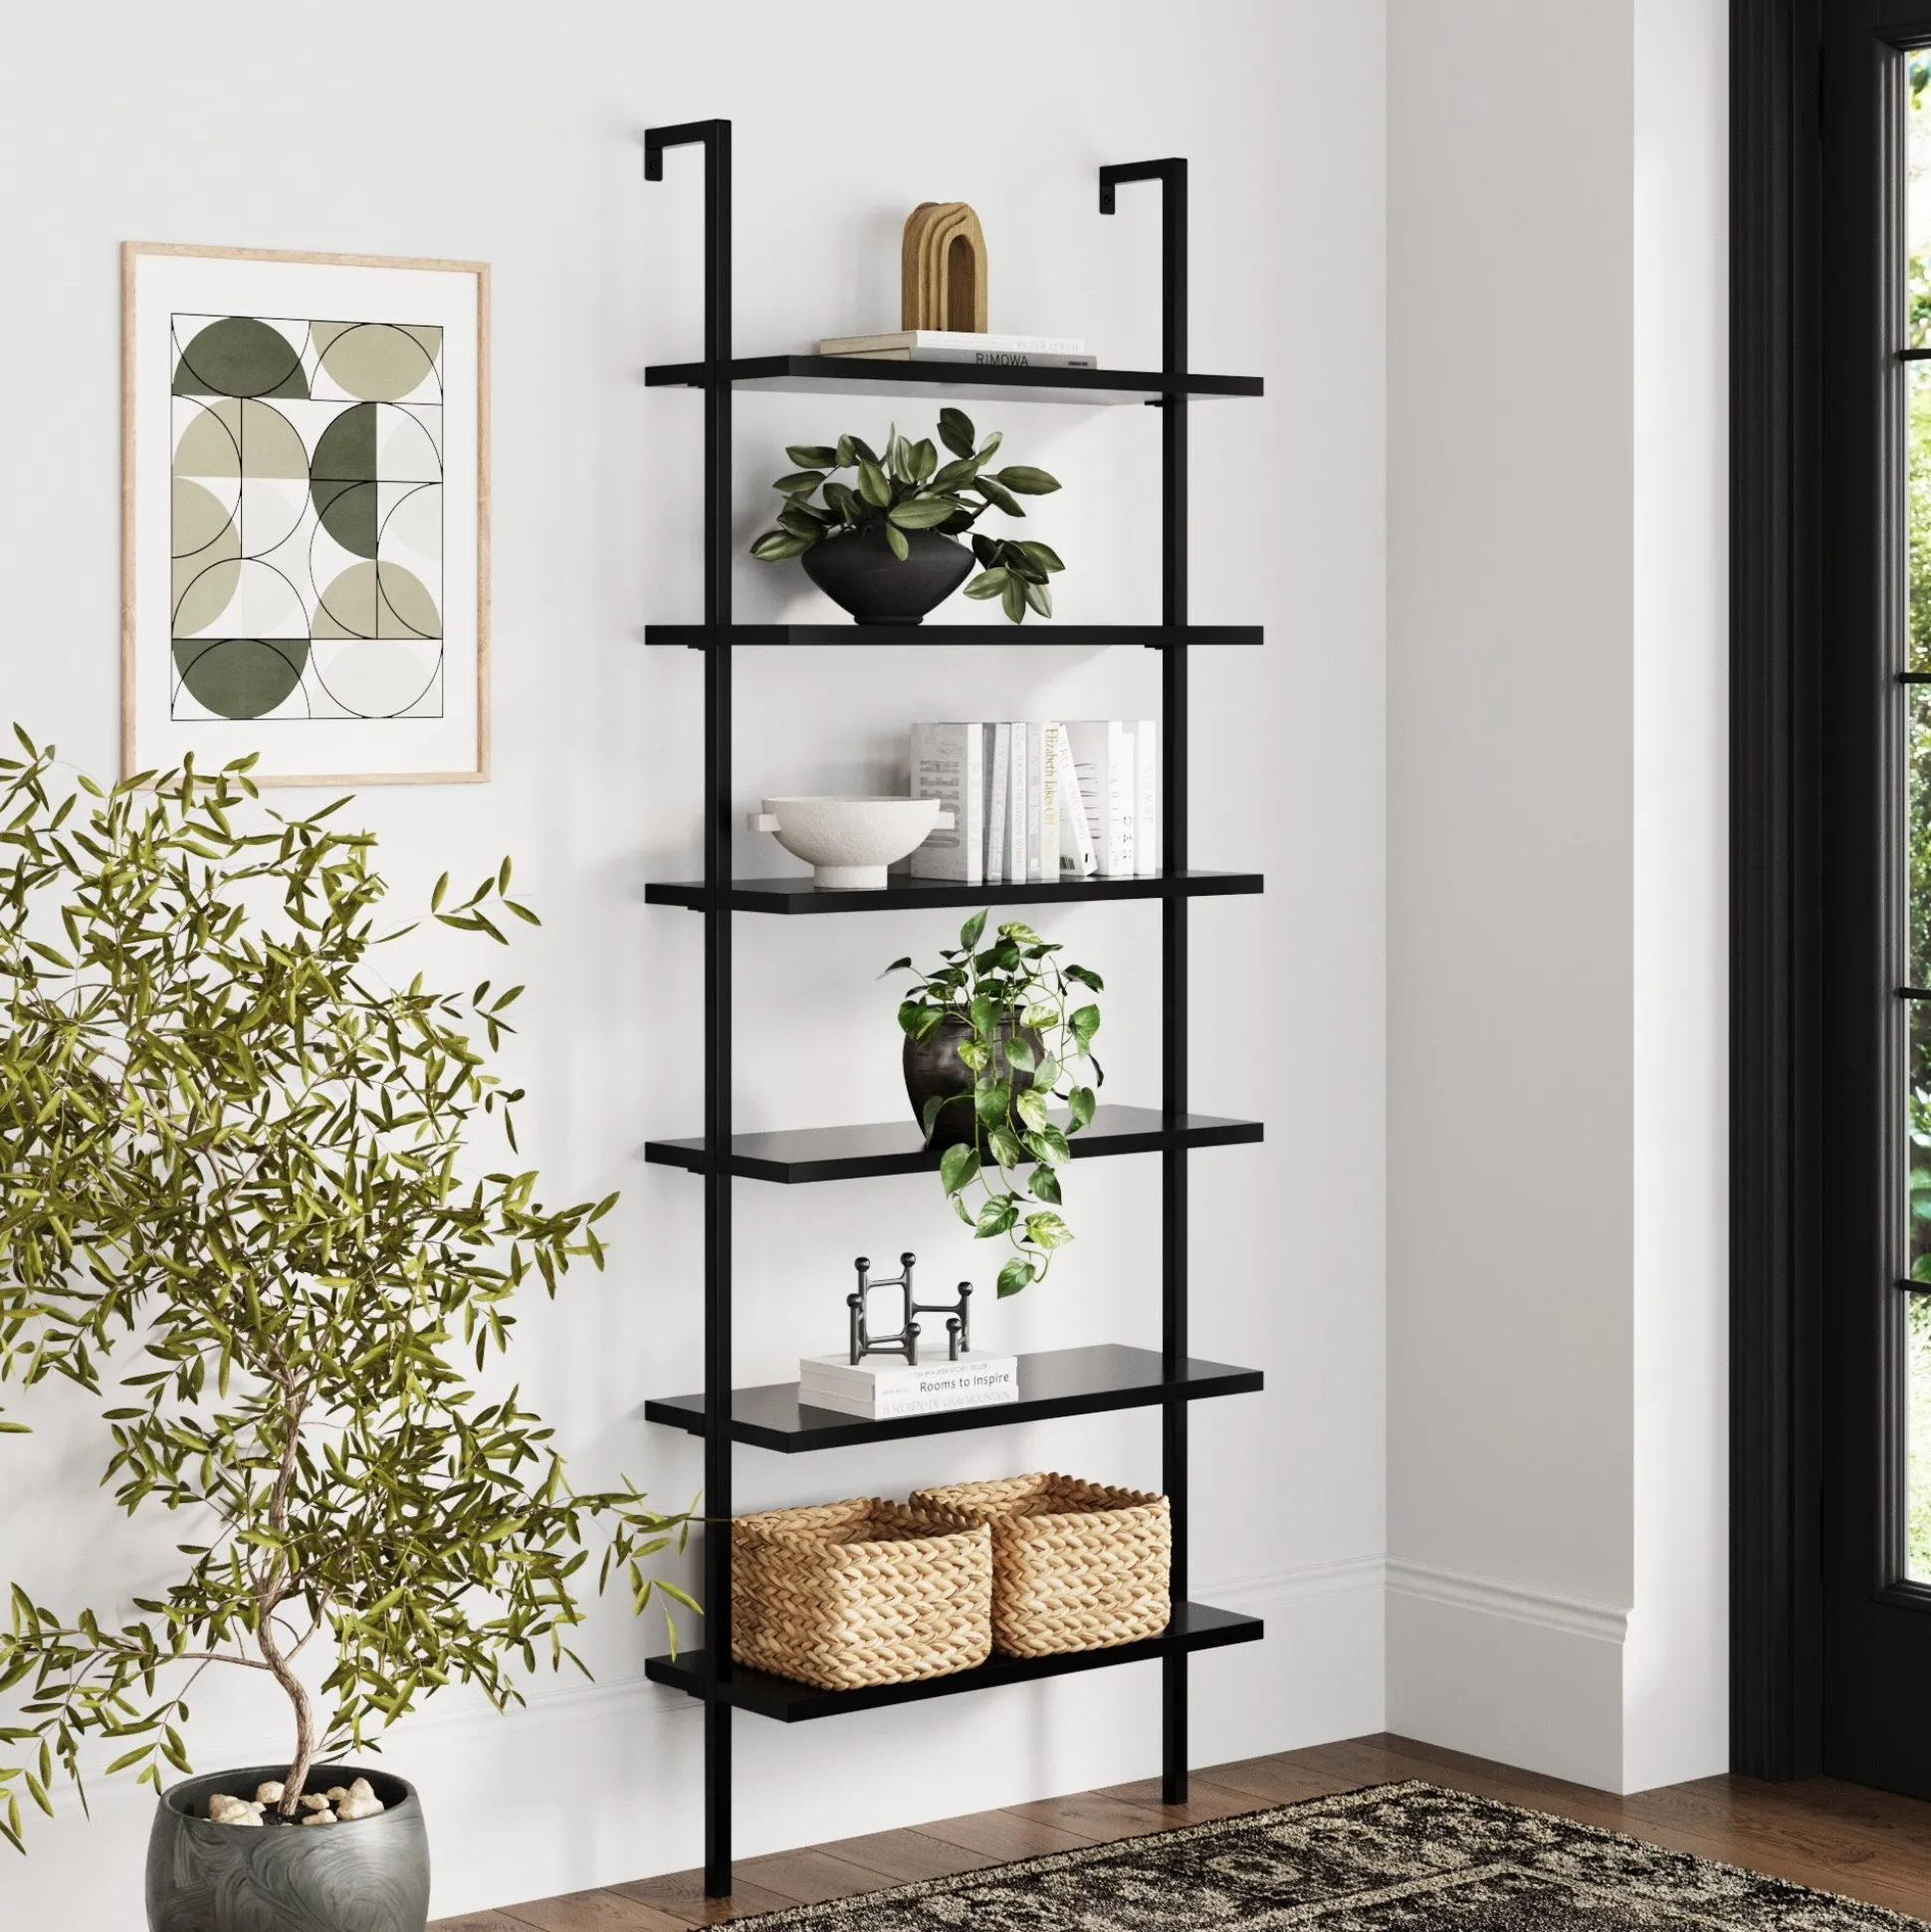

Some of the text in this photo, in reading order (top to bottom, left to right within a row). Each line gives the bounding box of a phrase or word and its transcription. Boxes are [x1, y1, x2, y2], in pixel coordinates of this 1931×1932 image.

[975, 351, 1029, 367] RIMOWA
[1045, 729, 1058, 776] Elizabeth
[920, 1380, 957, 1393] Rooms
[960, 1377, 970, 1388] to
[973, 1372, 1009, 1388] Inspire
